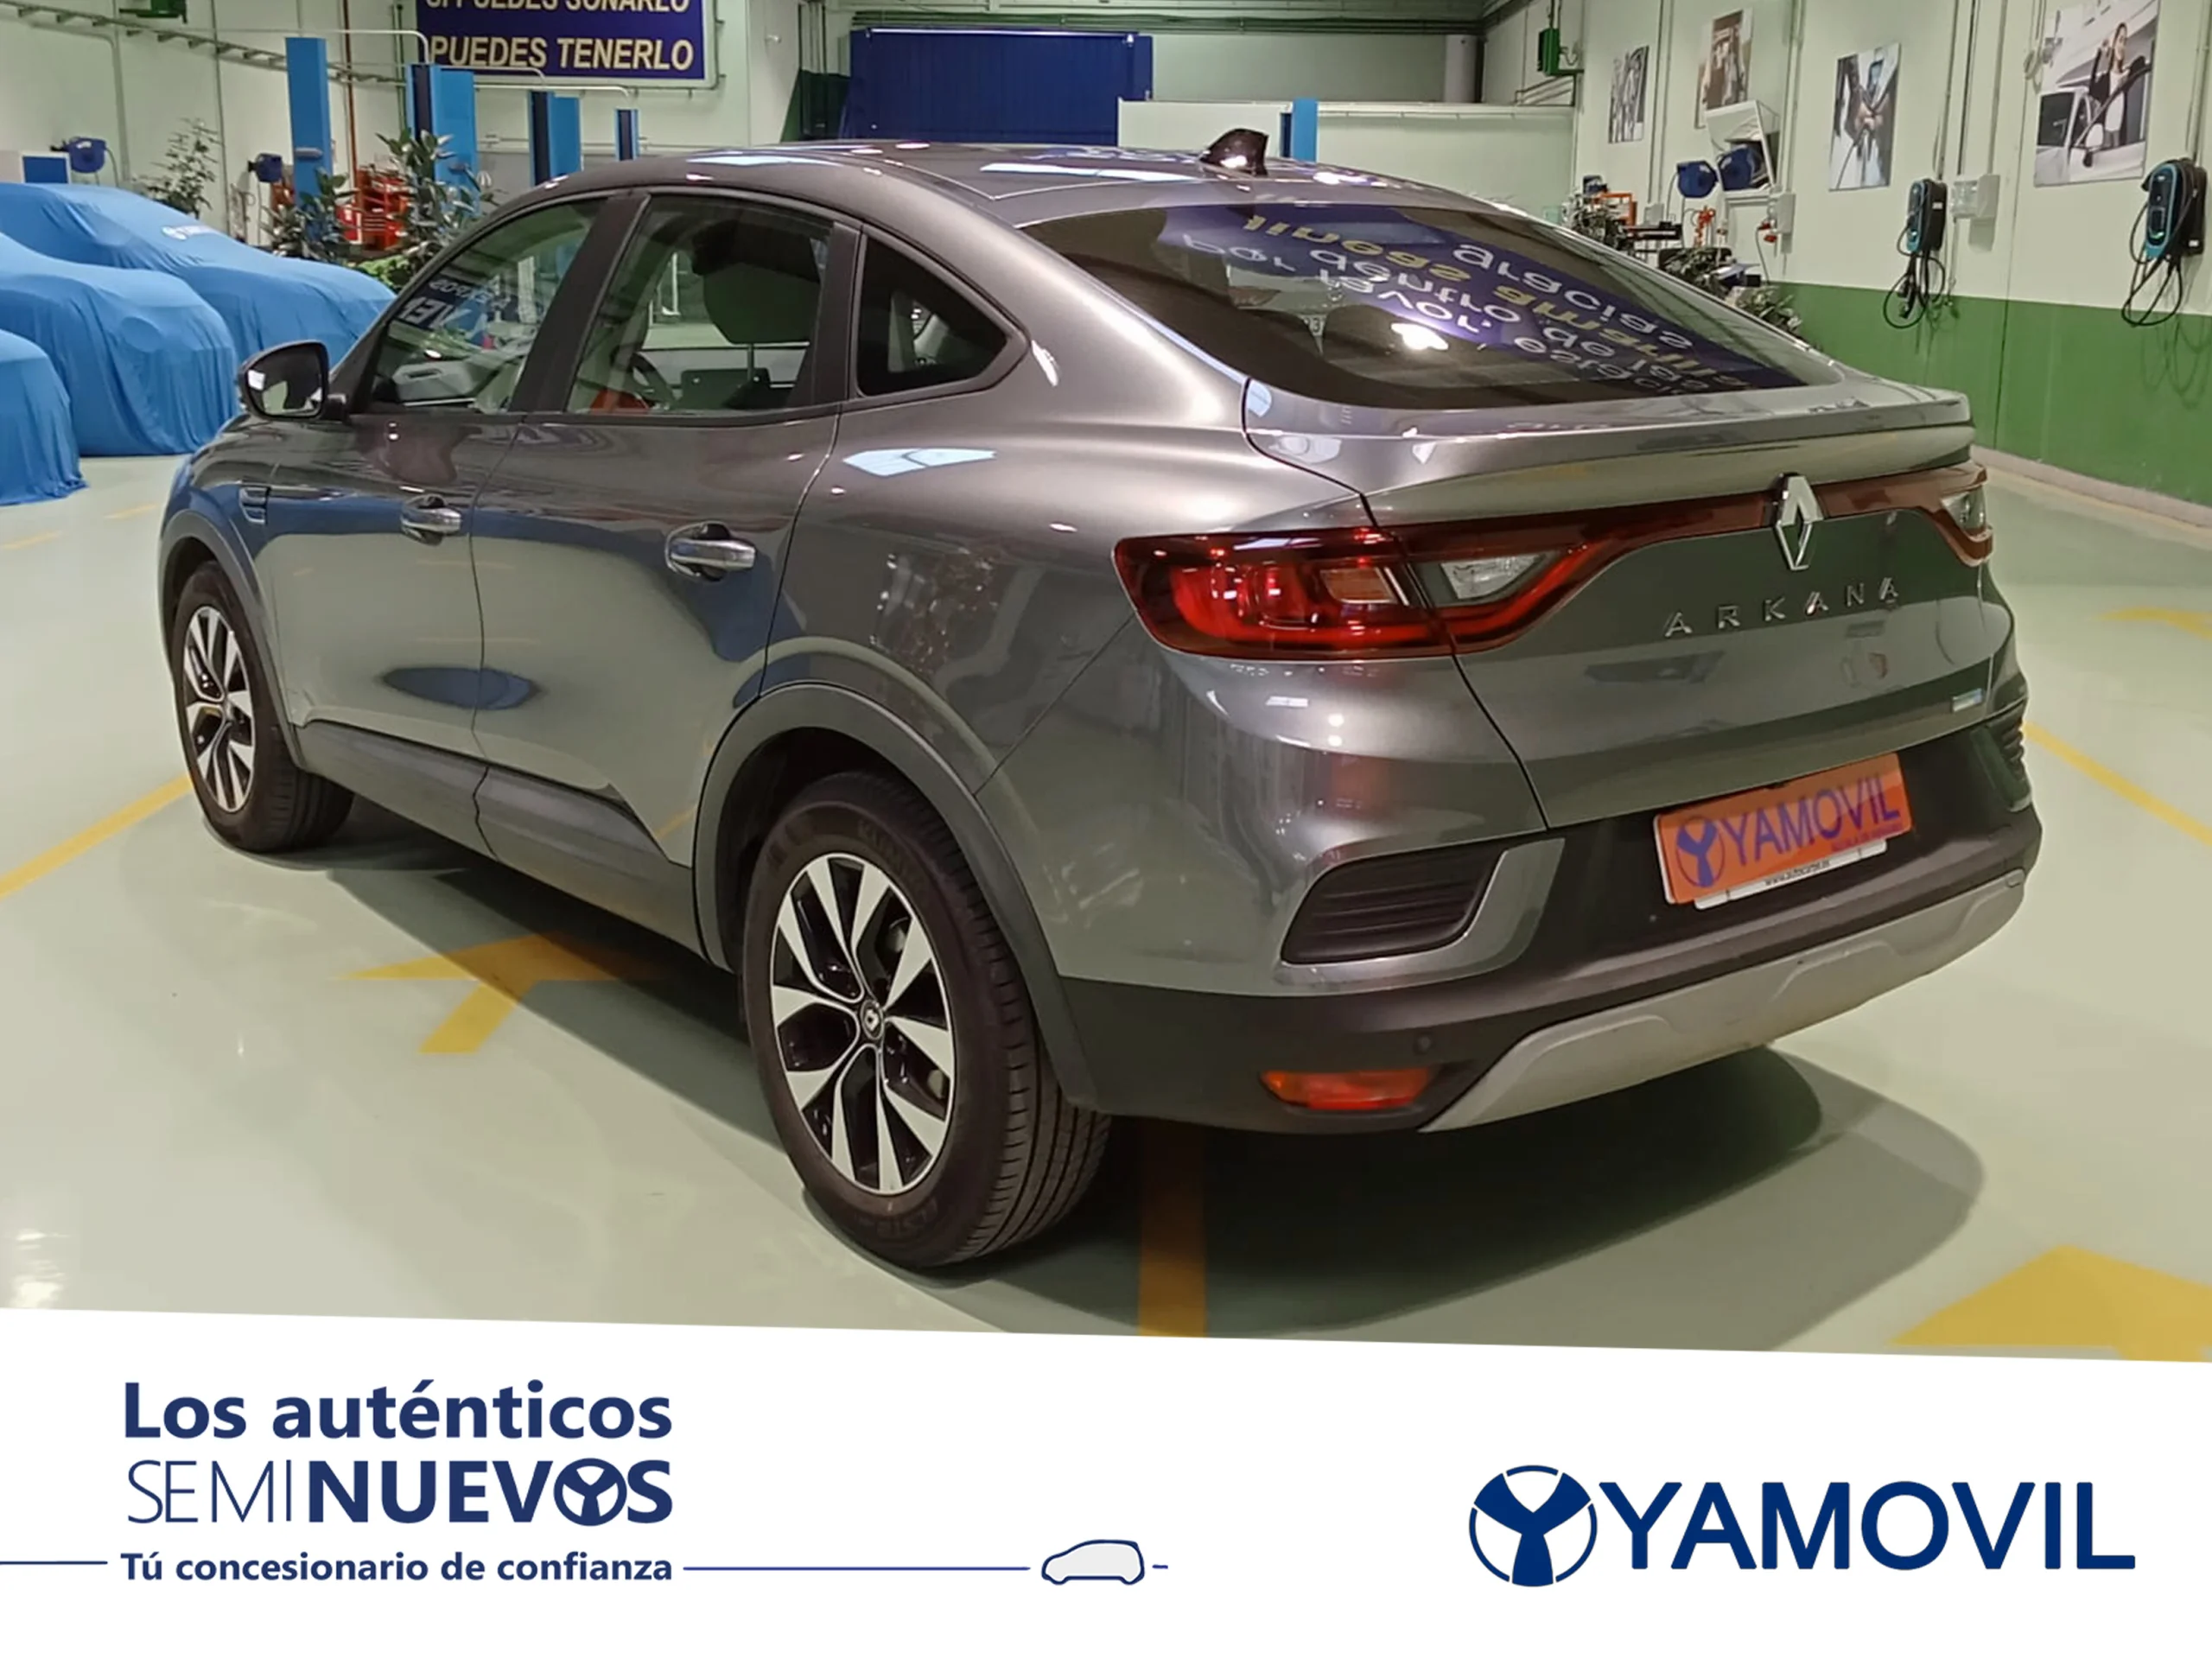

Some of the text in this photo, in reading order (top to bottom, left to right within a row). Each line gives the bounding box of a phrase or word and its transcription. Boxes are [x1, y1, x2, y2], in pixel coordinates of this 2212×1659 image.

[432, 35, 694, 71] PUEDES TENERLO
[1664, 576, 1899, 638] ARKANA
[1718, 772, 1901, 867] YAMOVIL
